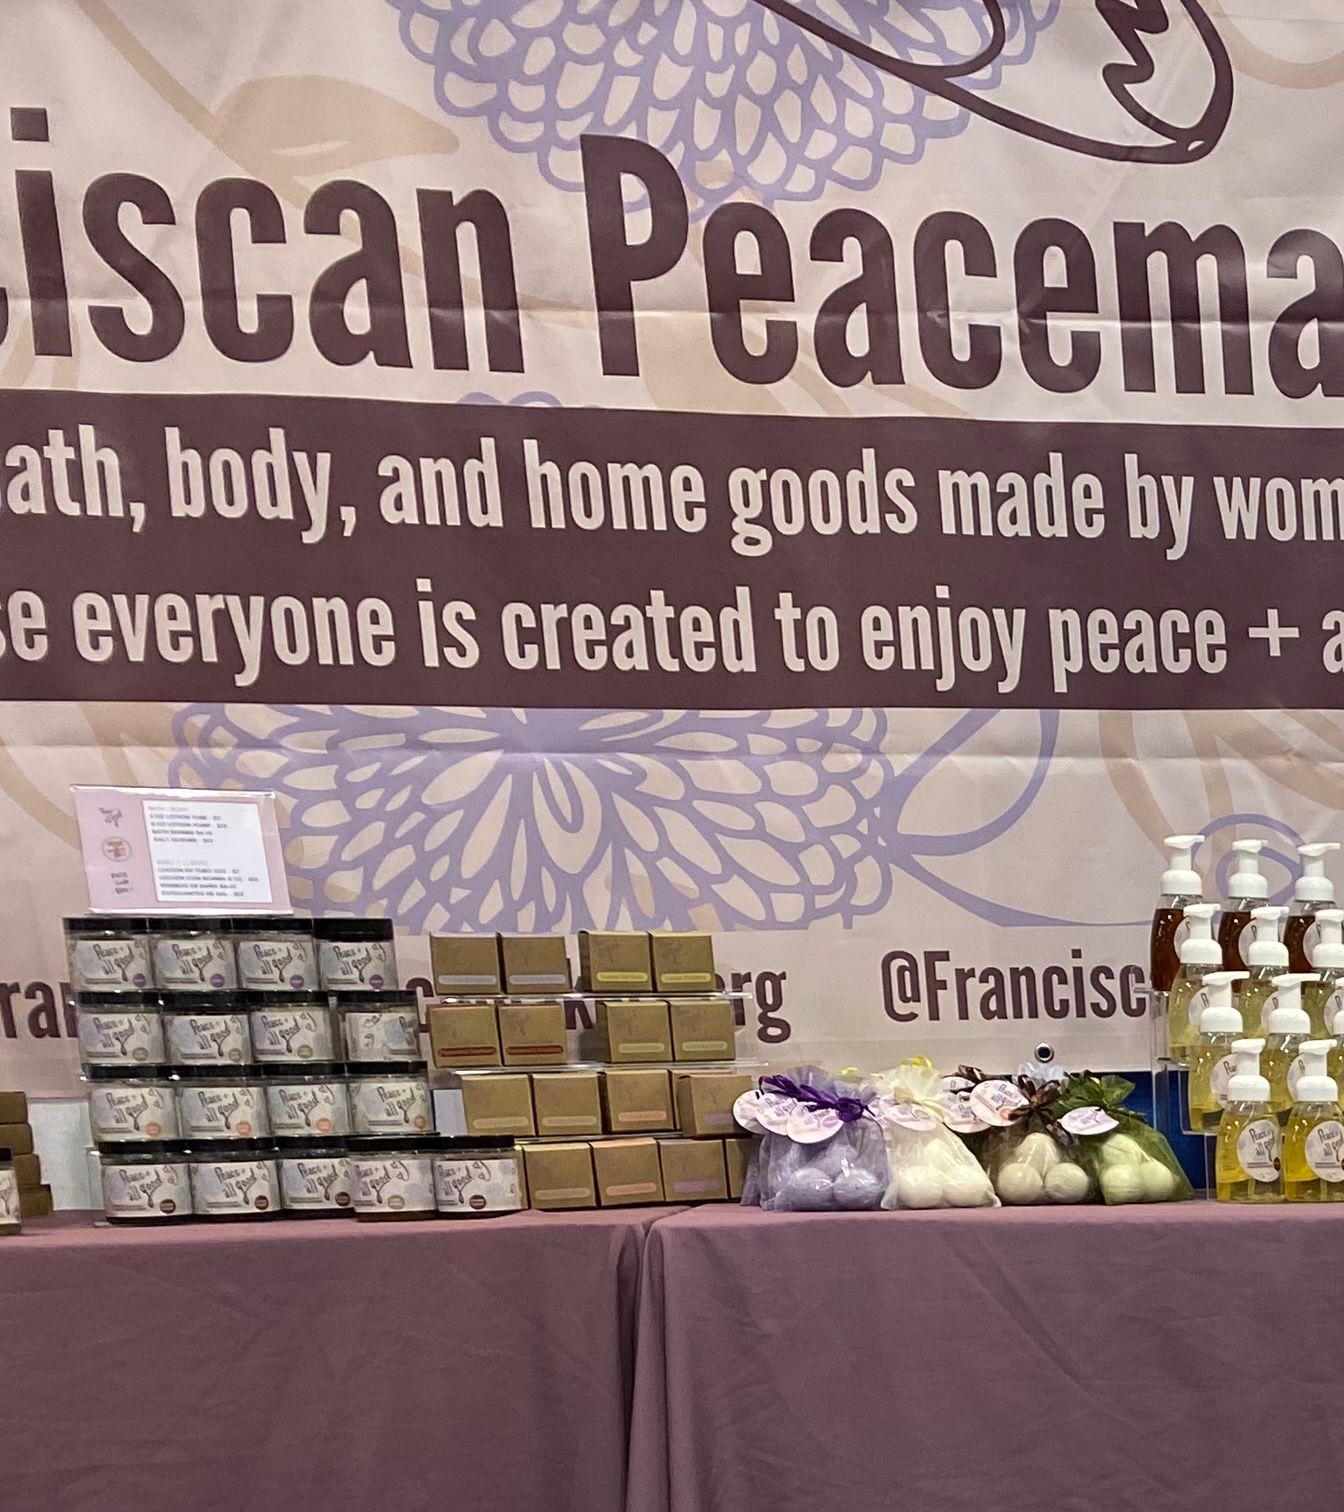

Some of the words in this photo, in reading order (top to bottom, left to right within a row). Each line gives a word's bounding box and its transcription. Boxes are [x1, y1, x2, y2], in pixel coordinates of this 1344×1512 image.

[0, 108, 525, 374] iscan
[0, 424, 145, 533] ath,
[165, 427, 357, 544] body,
[378, 437, 503, 529] and
[524, 439, 706, 532] home
[728, 448, 917, 556] goods
[938, 452, 1105, 539] made
[1124, 453, 1194, 560] by
[72, 590, 395, 687] everyone
[415, 578, 480, 670] is
[501, 587, 757, 674] created
[773, 592, 840, 674] to
[860, 585, 1026, 693] enjoy
[1052, 607, 1228, 694] peace
[1249, 608, 1300, 658] +
